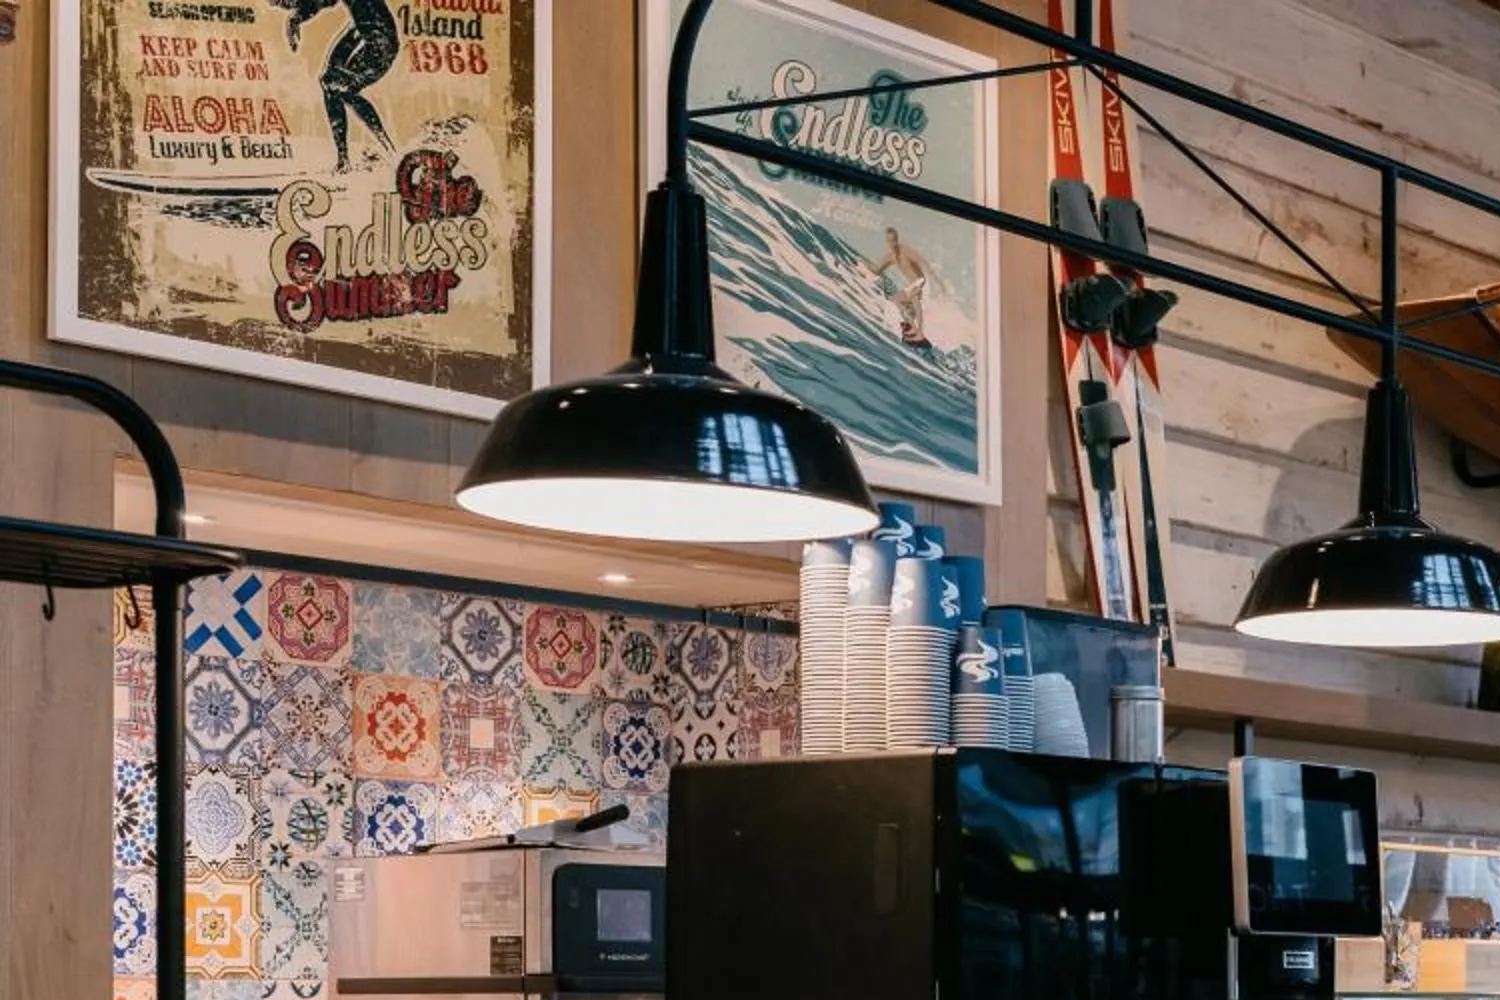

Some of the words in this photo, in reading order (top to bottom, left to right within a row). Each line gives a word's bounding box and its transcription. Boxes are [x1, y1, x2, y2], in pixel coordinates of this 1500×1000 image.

[398, 5, 484, 40] Island
[139, 35, 198, 58] KEEP
[206, 38, 265, 61] CALM
[407, 39, 489, 75] 1968
[140, 57, 181, 78] AND
[187, 60, 237, 80] SURF
[244, 63, 269, 81] ON
[143, 94, 292, 135] ALOHA
[758, 59, 927, 181] Endless
[869, 68, 928, 135] The
[149, 135, 216, 165] Luxury
[221, 136, 236, 159] &
[239, 136, 294, 160] Beach
[396, 149, 482, 224] The
[270, 179, 489, 284] Endless
[274, 240, 462, 334] Summer
